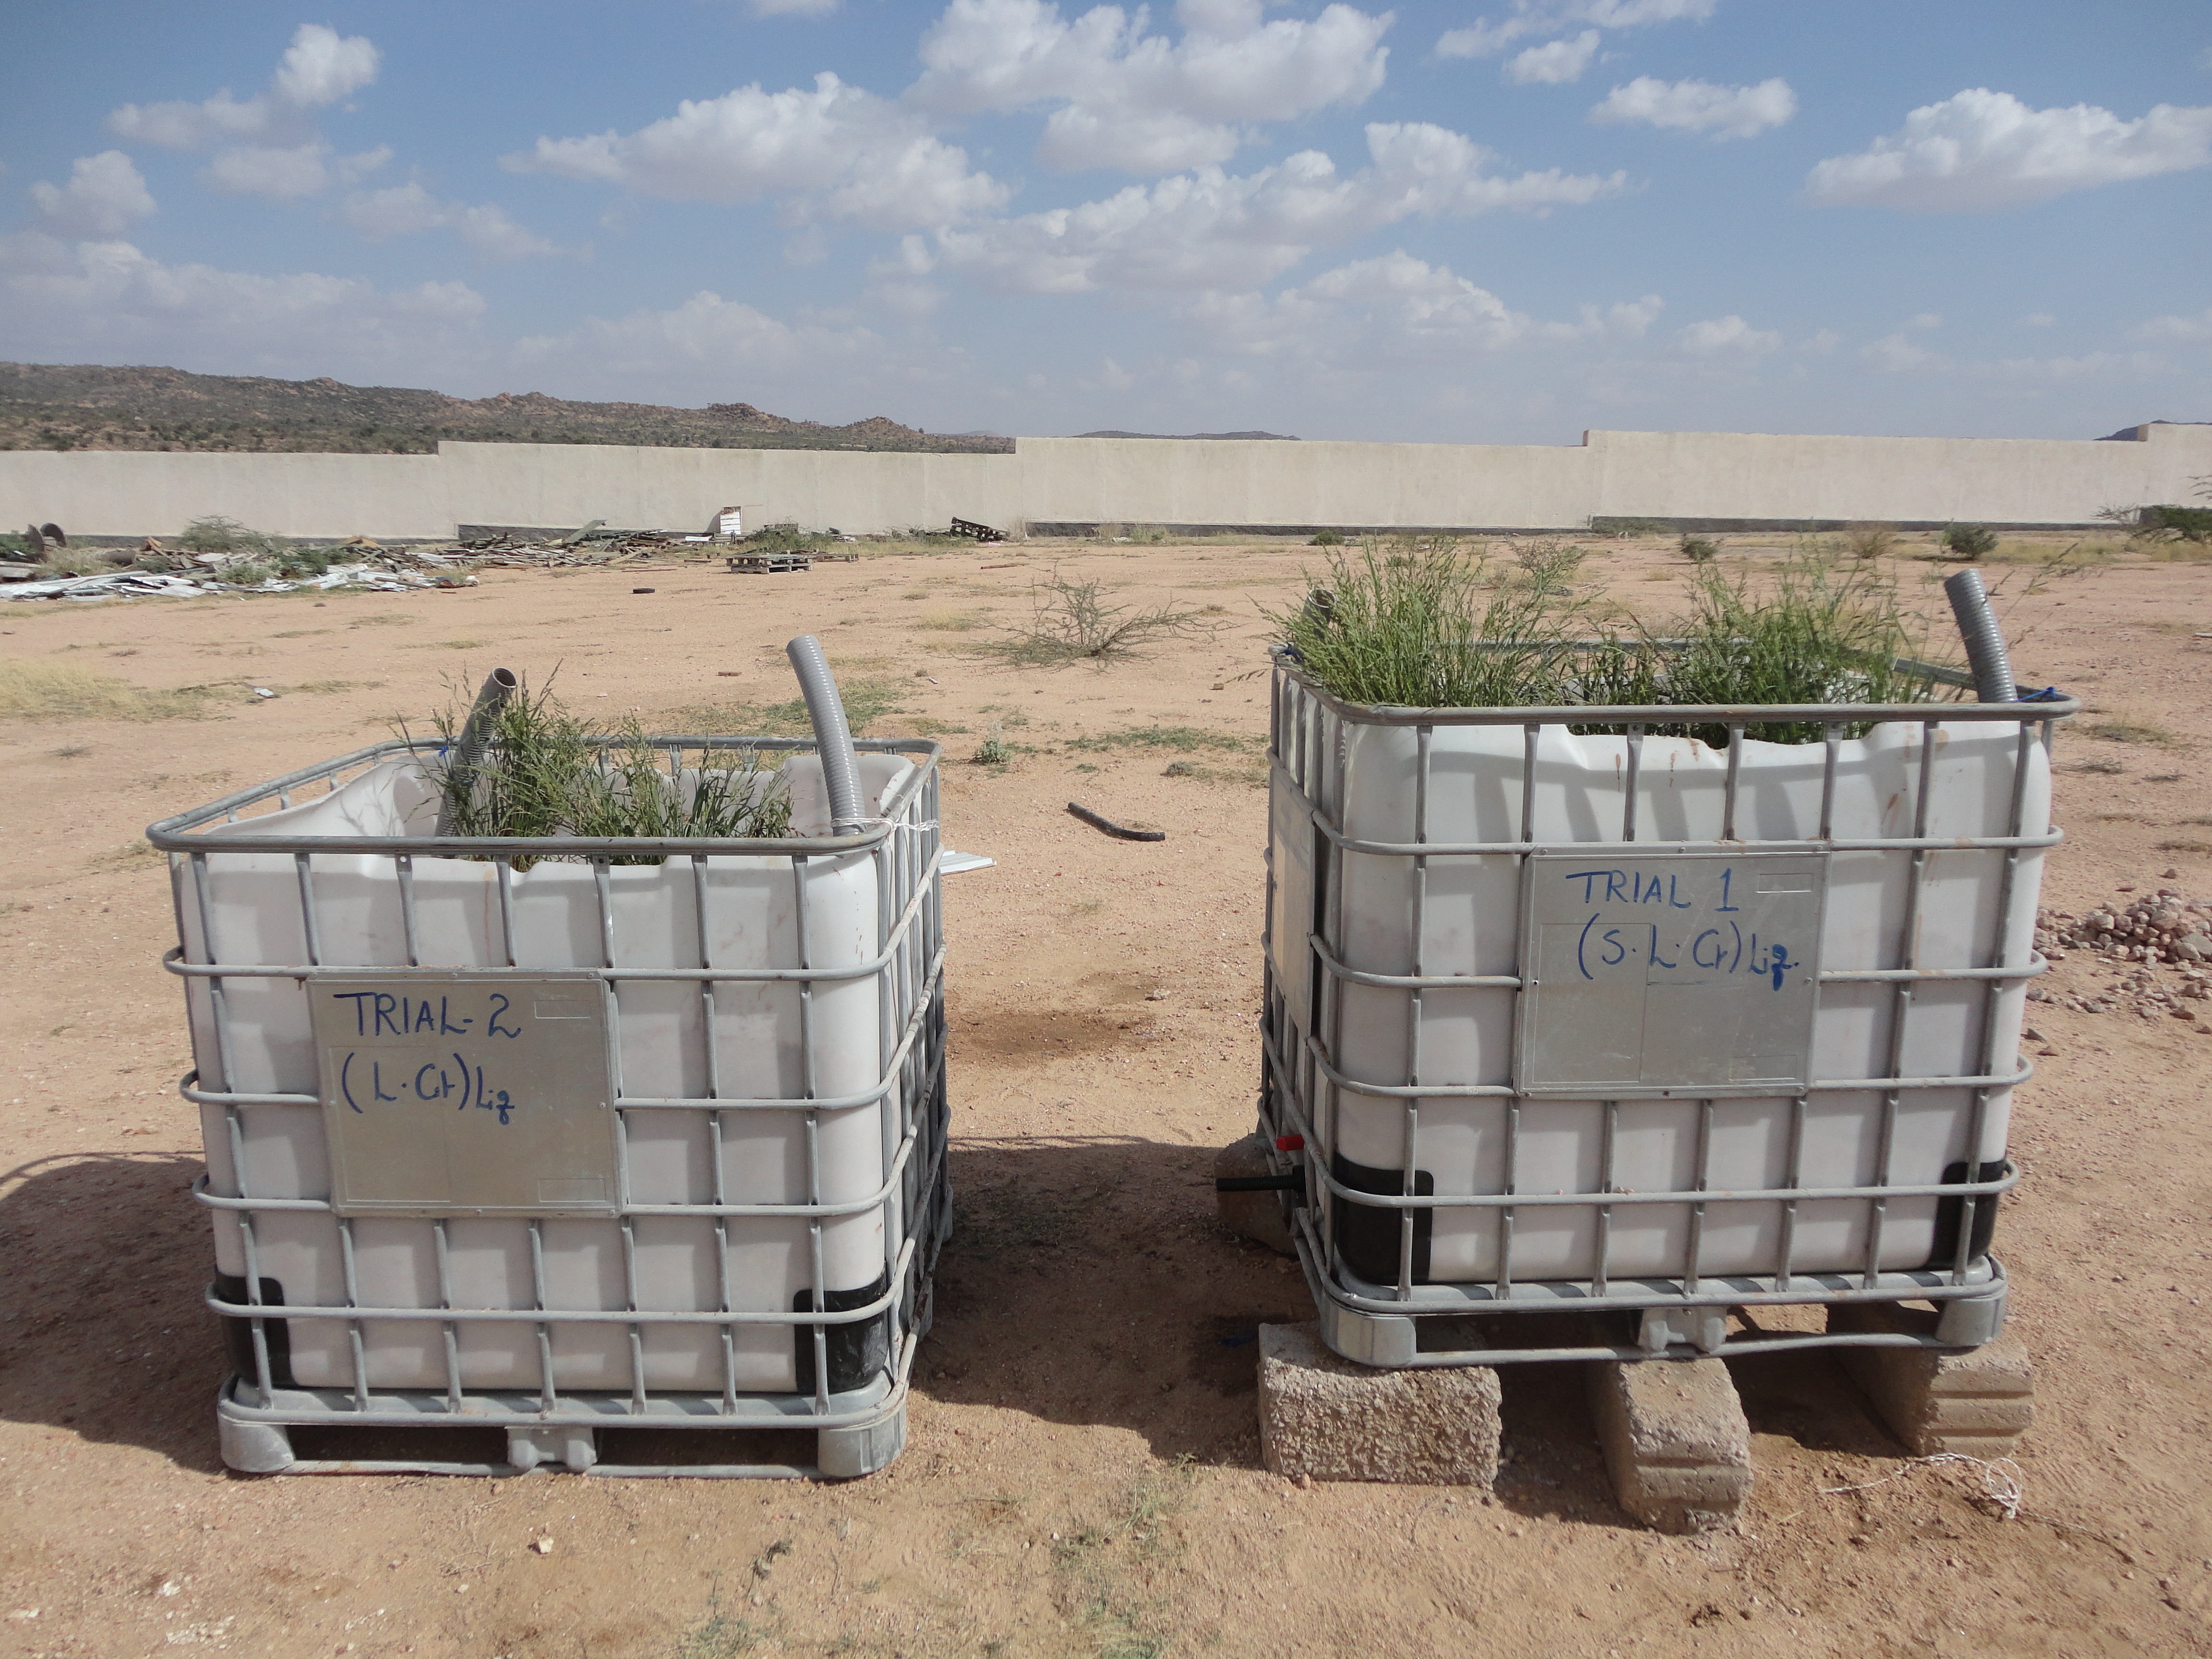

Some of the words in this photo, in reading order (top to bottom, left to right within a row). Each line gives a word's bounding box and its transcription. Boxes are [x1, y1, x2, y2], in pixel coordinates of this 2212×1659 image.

[1565, 869, 1692, 909] TRIAL
[1715, 867, 1739, 912] 1
[488, 993, 521, 1039] 2
